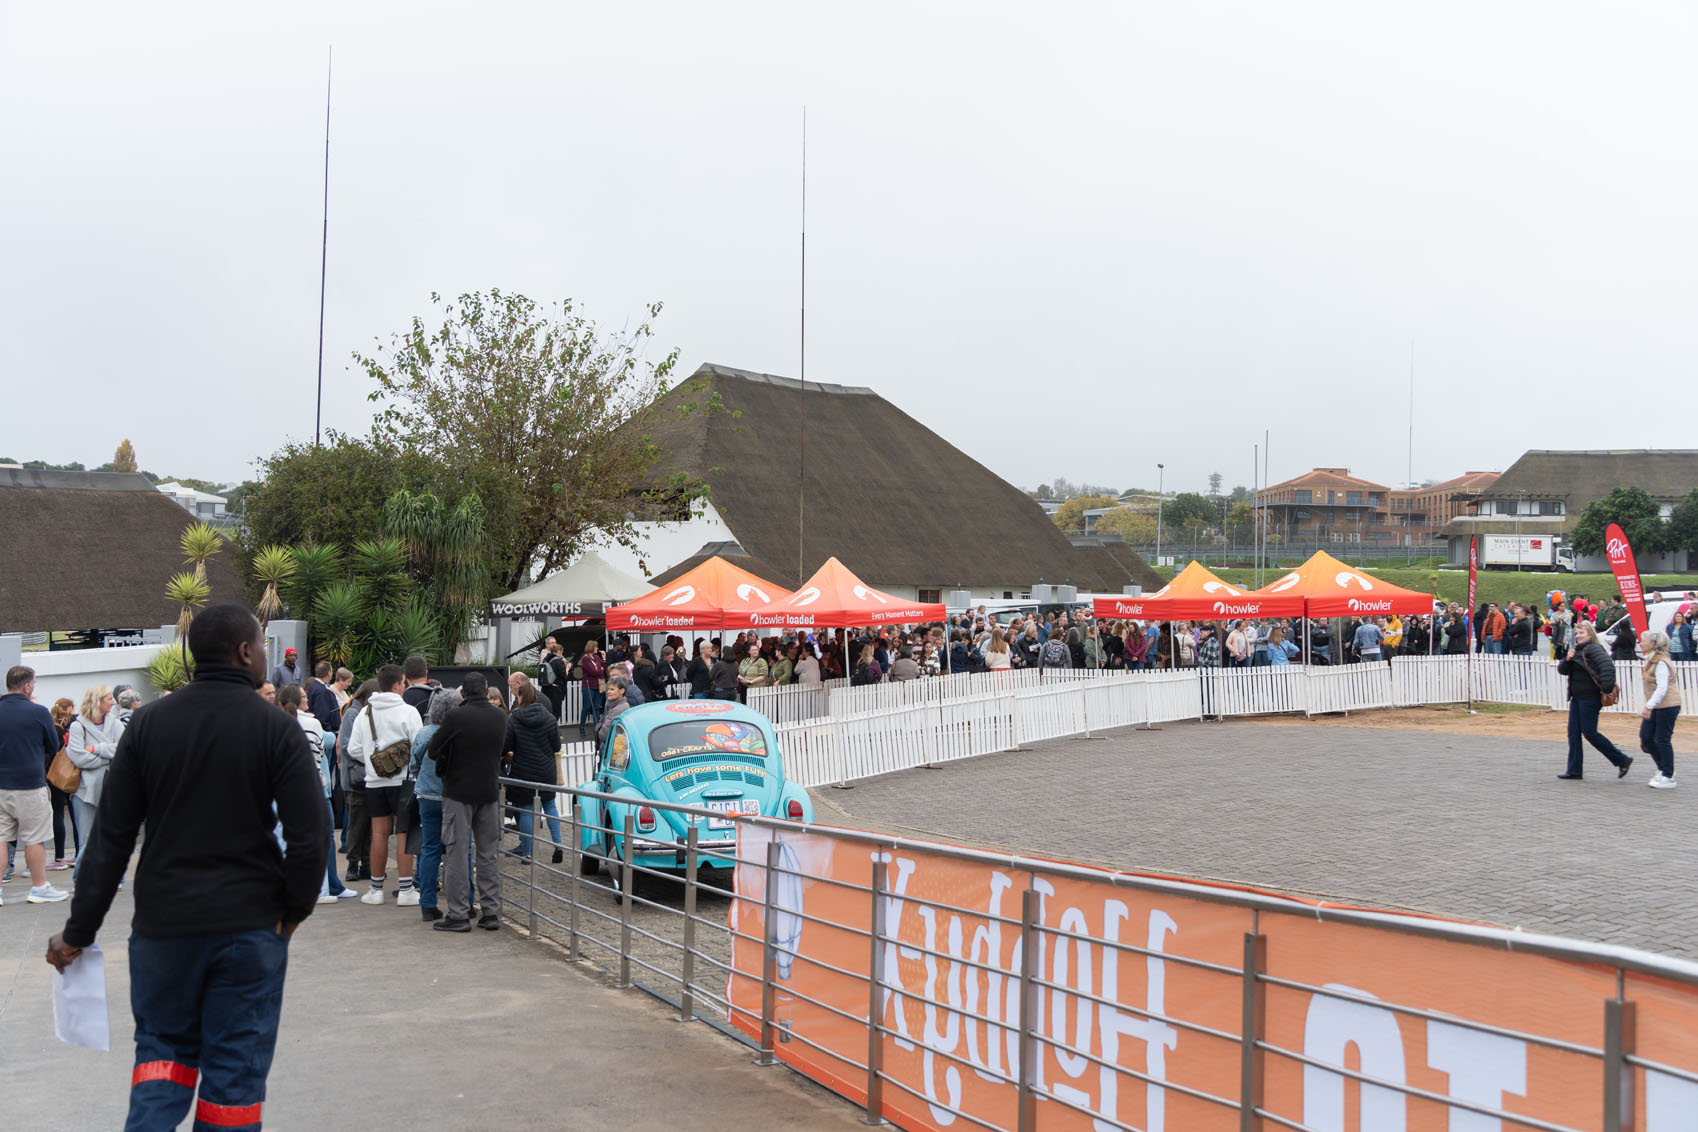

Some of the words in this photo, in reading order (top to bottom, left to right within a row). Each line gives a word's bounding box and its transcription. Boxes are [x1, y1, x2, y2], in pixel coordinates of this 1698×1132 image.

[491, 602, 582, 615] WOOLWORTHS
[1122, 603, 1143, 615] howler
[1225, 602, 1260, 614] howler
[1359, 599, 1392, 611] howler
[639, 616, 665, 626] howler
[666, 615, 695, 626] loaded
[759, 613, 786, 625] howler
[786, 614, 815, 625] loaded
[871, 612, 885, 620] Every
[885, 611, 905, 619] Moment
[682, 745, 713, 753] CRAFTS
[664, 771, 684, 783] Lets
[686, 766, 712, 775] have
[744, 765, 767, 778] FUN!
